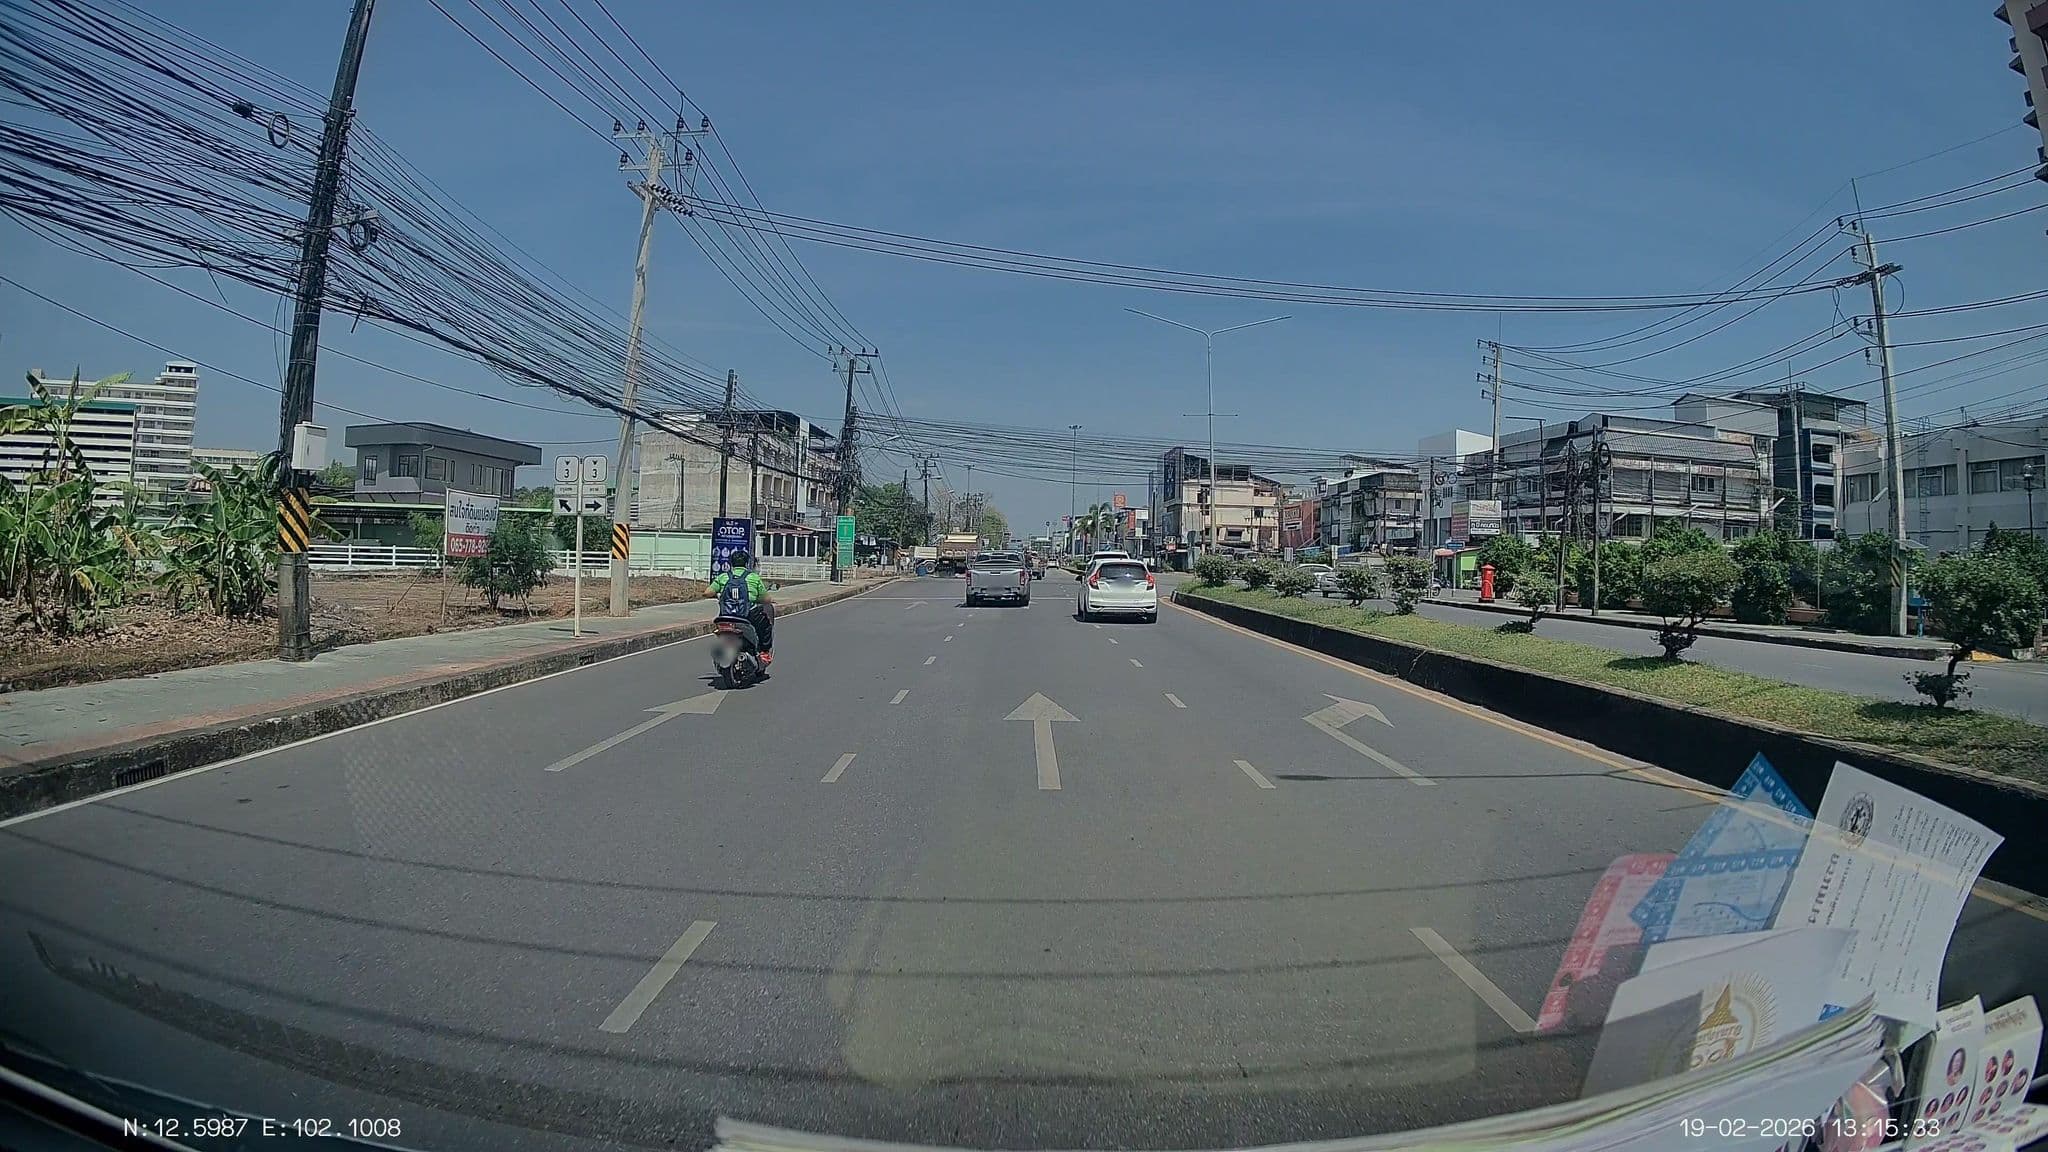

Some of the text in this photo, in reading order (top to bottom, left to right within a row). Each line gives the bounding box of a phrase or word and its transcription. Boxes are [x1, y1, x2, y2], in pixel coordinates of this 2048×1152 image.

[564, 469, 570, 478] 3
[592, 469, 598, 478] 3
[719, 526, 745, 535] OTOP
